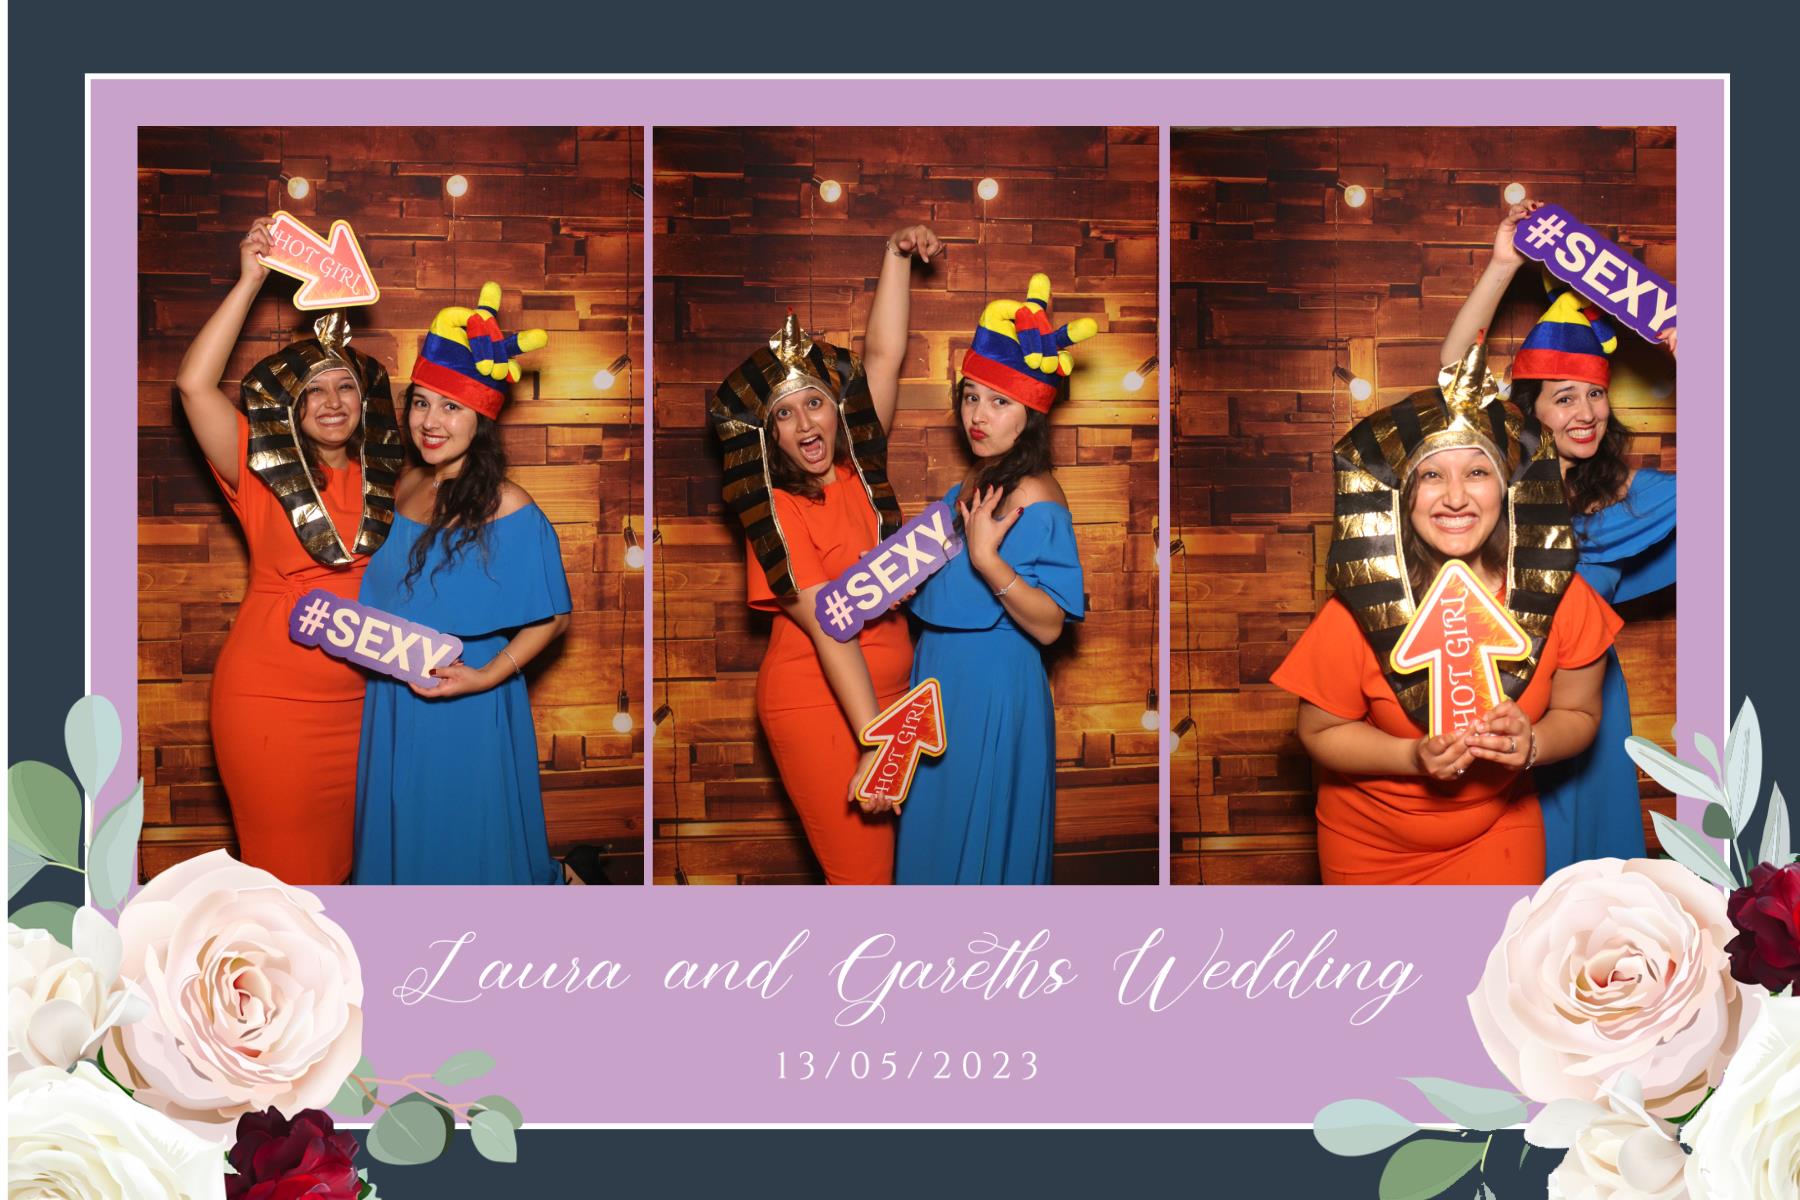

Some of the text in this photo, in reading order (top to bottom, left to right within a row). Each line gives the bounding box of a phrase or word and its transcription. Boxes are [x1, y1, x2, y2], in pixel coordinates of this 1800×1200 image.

[274, 229, 361, 295] HOT GIRL
[1525, 214, 1676, 332] #SEXY
[825, 510, 952, 631] #SEXY
[299, 598, 453, 679] #SEXY
[1441, 587, 1476, 732] HOT GIRL
[873, 698, 933, 798] HOT GIRL
